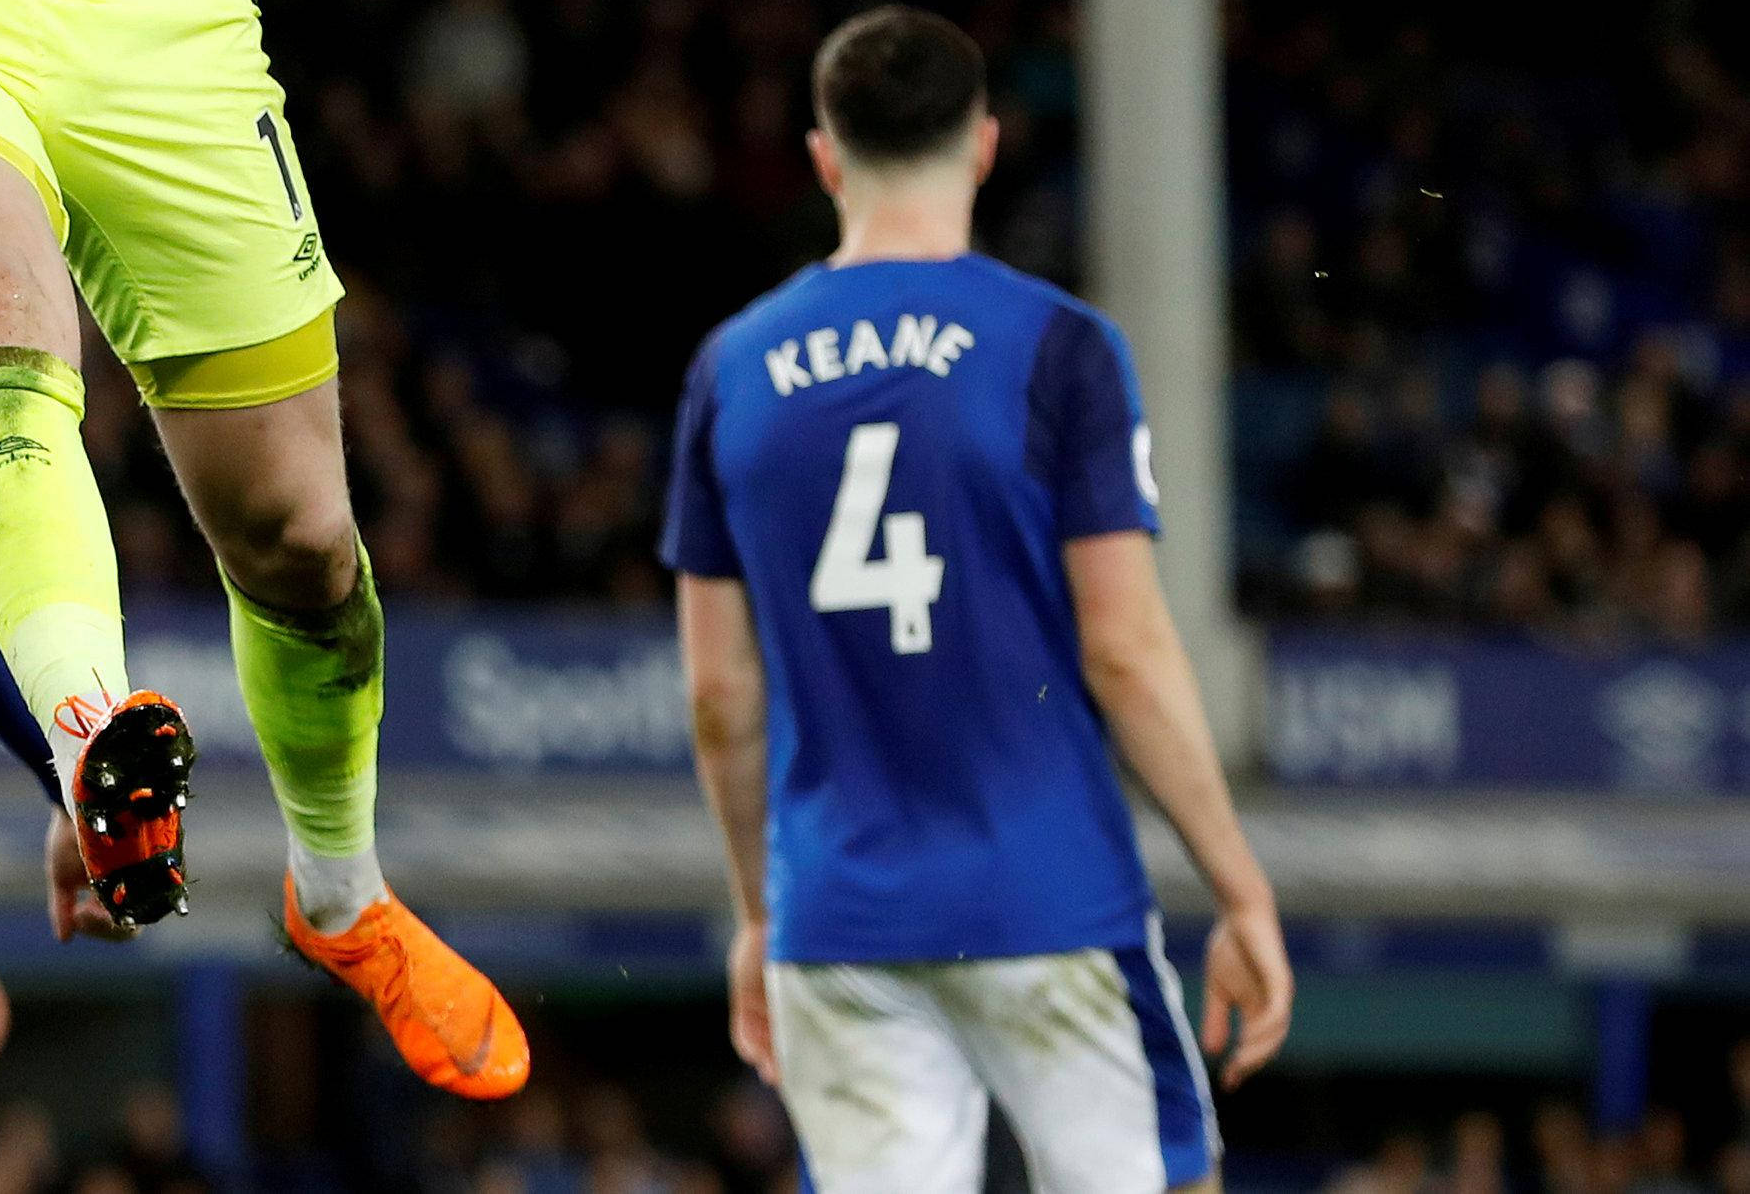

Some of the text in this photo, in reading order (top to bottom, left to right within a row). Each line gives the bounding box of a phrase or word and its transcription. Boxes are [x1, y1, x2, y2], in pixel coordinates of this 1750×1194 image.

[256, 111, 303, 221] 1
[764, 313, 976, 397] KEANE
[809, 421, 946, 655] 4
